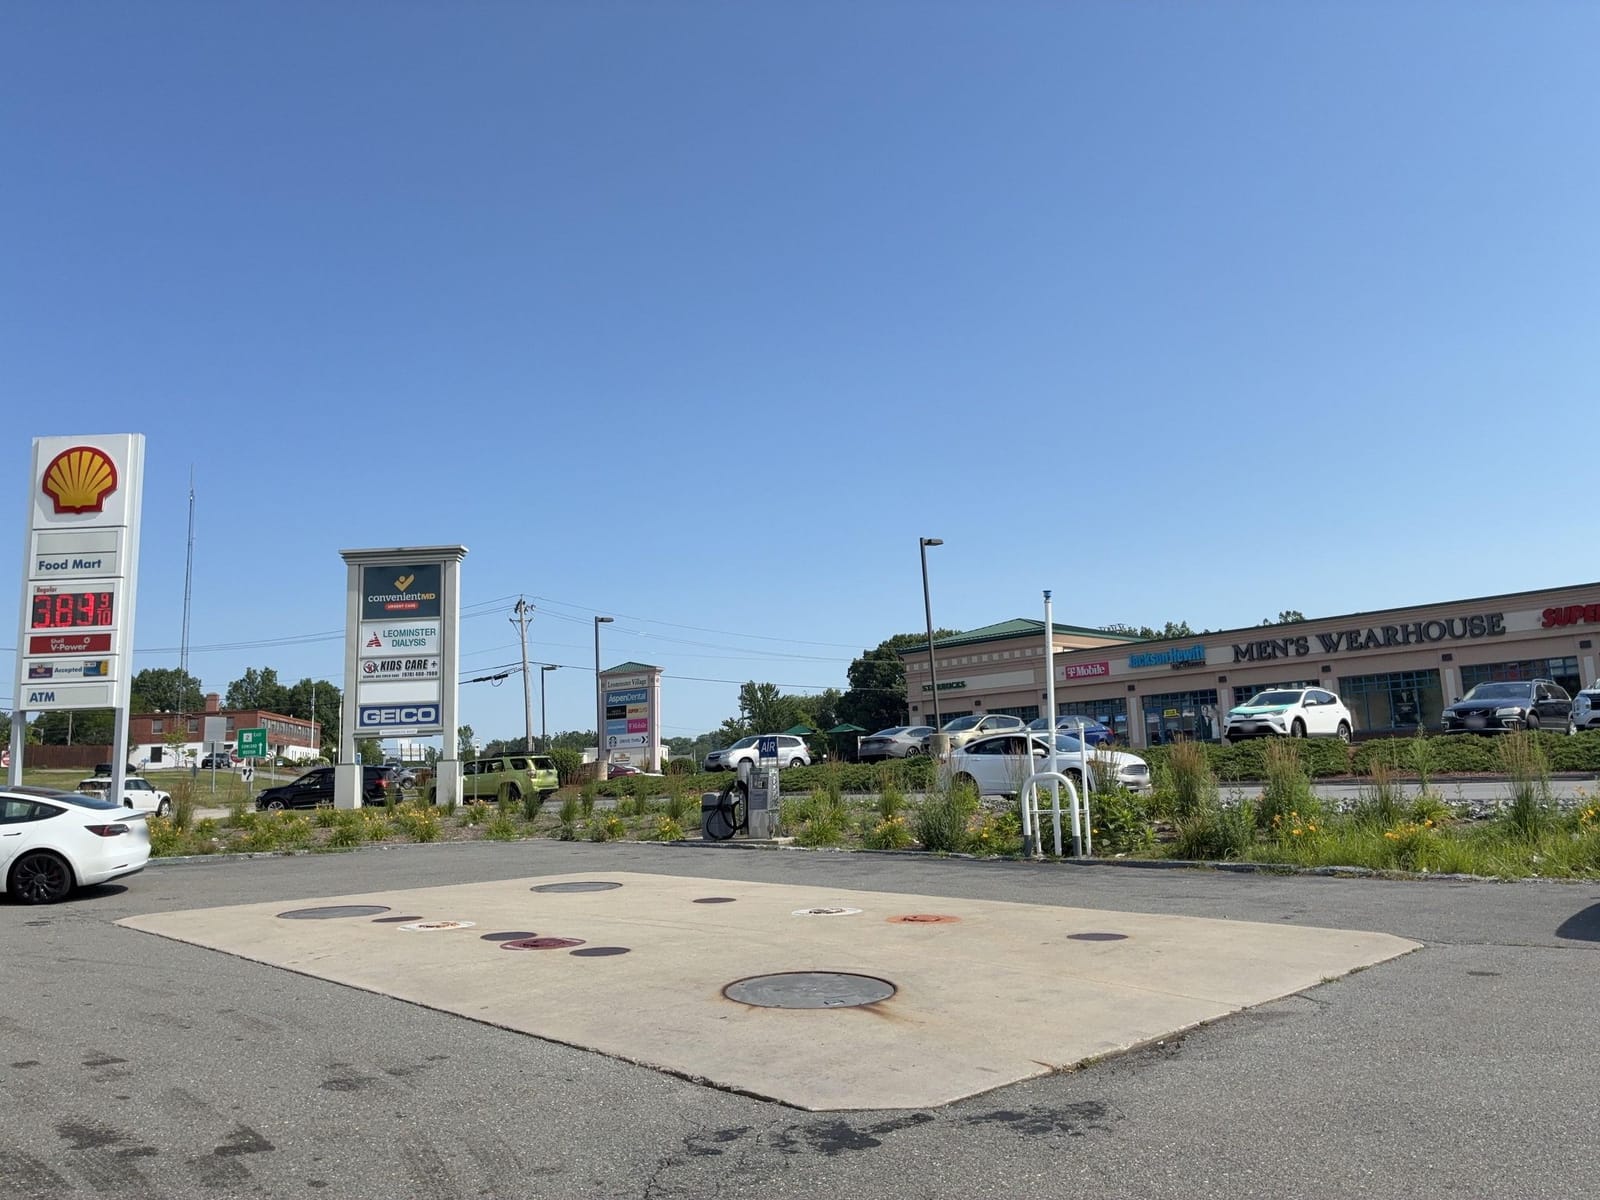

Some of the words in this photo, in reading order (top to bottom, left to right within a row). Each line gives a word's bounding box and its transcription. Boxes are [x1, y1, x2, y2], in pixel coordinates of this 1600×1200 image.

[38, 559, 68, 571] Food
[72, 558, 102, 570] Mart
[368, 592, 436, 602] convenientMD
[383, 628, 436, 638] LEOMINSTER
[1232, 636, 1310, 663] MEN'S
[1316, 612, 1506, 653] WEARHOUSE
[51, 643, 87, 651] V-Power
[391, 638, 426, 647] DIALYSIS
[380, 660, 402, 671] KIDS
[405, 659, 429, 670] CARE
[29, 692, 55, 702] ATM
[363, 707, 436, 724] GEICO
[761, 741, 775, 752] AIR
